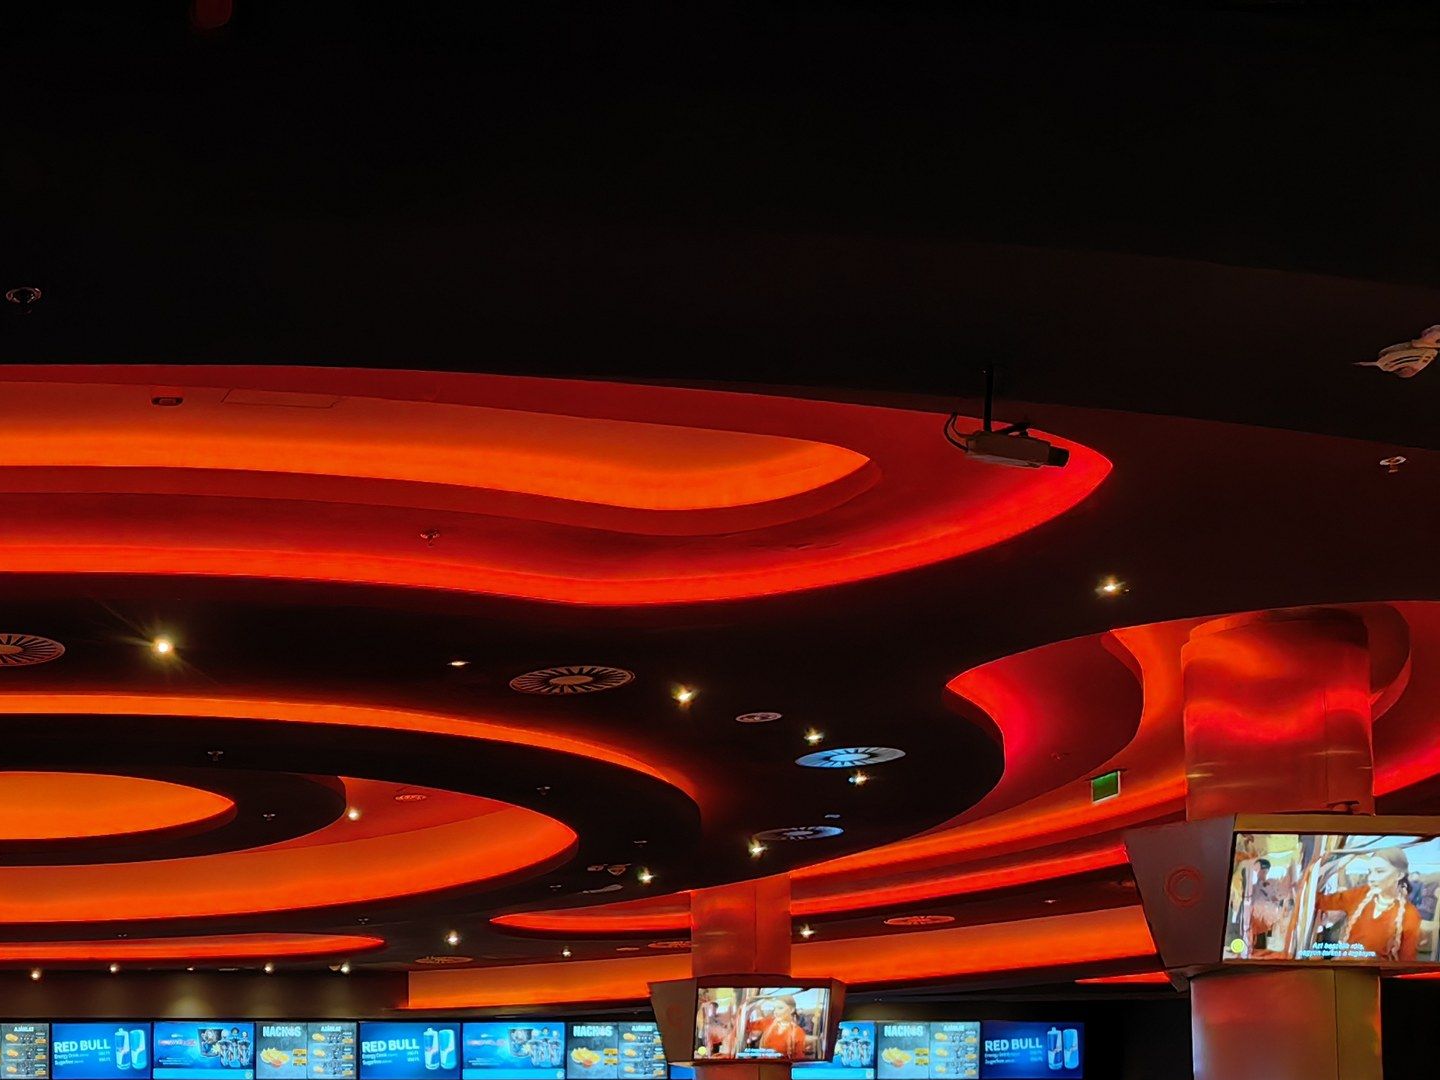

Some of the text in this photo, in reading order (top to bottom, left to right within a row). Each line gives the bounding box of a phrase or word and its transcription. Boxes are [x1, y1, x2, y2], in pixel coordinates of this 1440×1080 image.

[54, 1039, 111, 1053] RED BULL
[362, 1038, 420, 1053] RED BULL
[984, 1037, 1043, 1051] RED BULL
